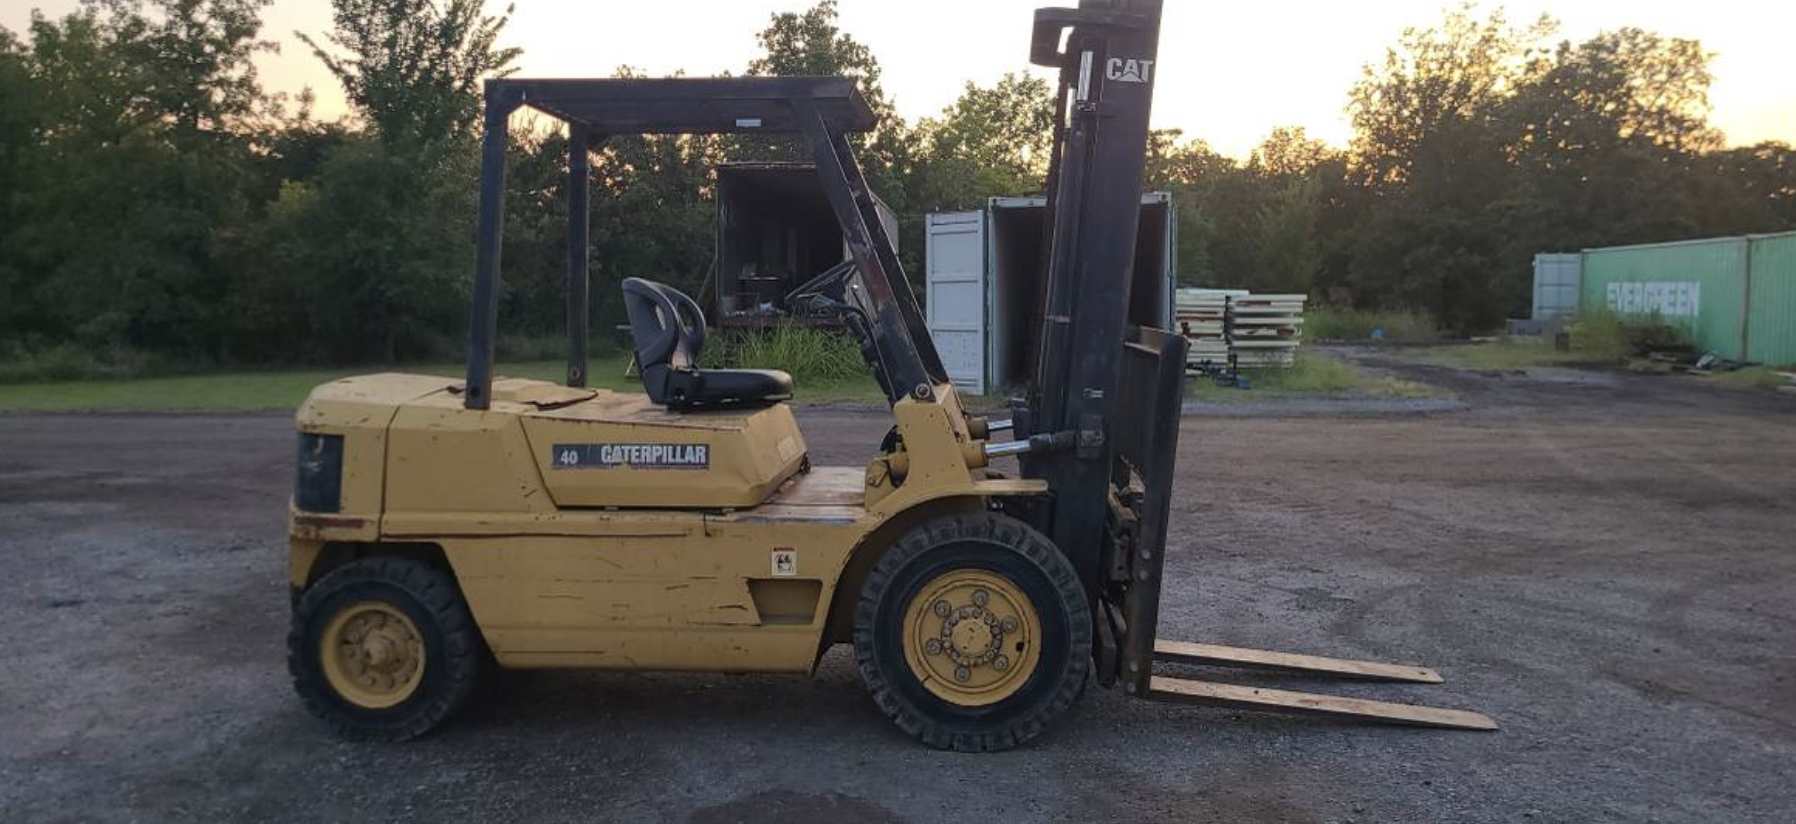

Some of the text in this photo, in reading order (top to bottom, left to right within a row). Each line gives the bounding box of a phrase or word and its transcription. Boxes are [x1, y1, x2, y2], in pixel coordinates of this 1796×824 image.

[1106, 58, 1153, 83] CAT
[1607, 282, 1700, 316] EVERGREEN
[560, 445, 706, 464] 40 CATERPILLAR
